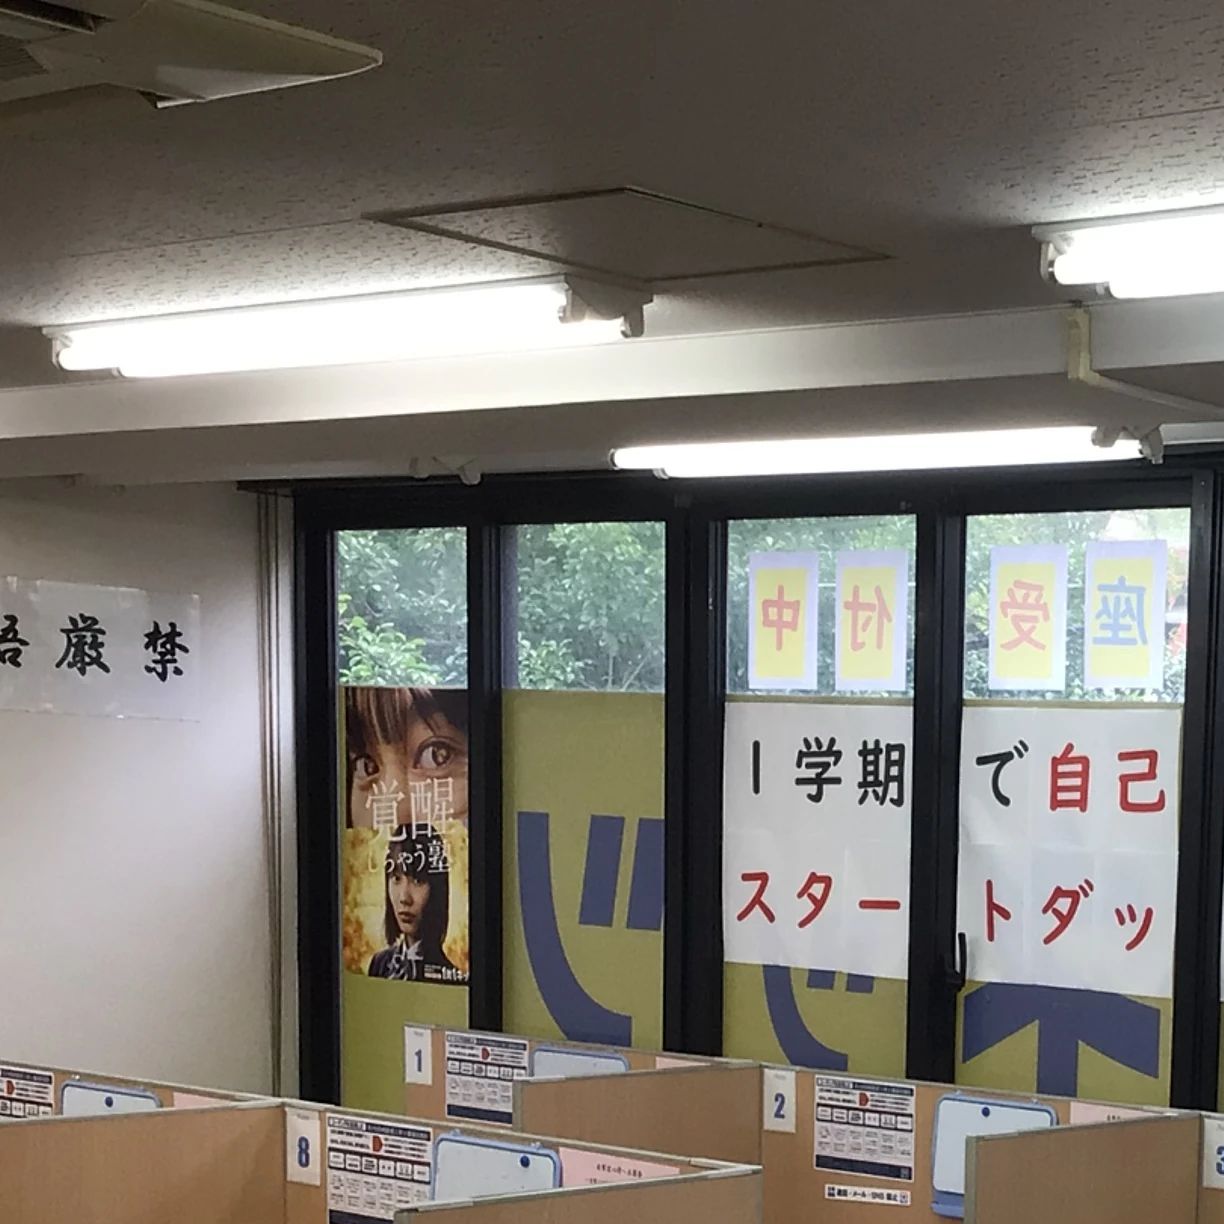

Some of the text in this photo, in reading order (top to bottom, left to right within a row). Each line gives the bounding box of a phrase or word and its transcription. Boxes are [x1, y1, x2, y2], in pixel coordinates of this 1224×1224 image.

[975, 739, 1167, 814] で自己
[365, 777, 456, 843] 覚醒
[368, 839, 453, 874] しちゃう塾
[736, 870, 902, 930] スター
[984, 878, 1154, 952] トダッ
[414, 1048, 423, 1073] 1
[773, 1092, 786, 1120] 2
[297, 1135, 310, 1169] 8
